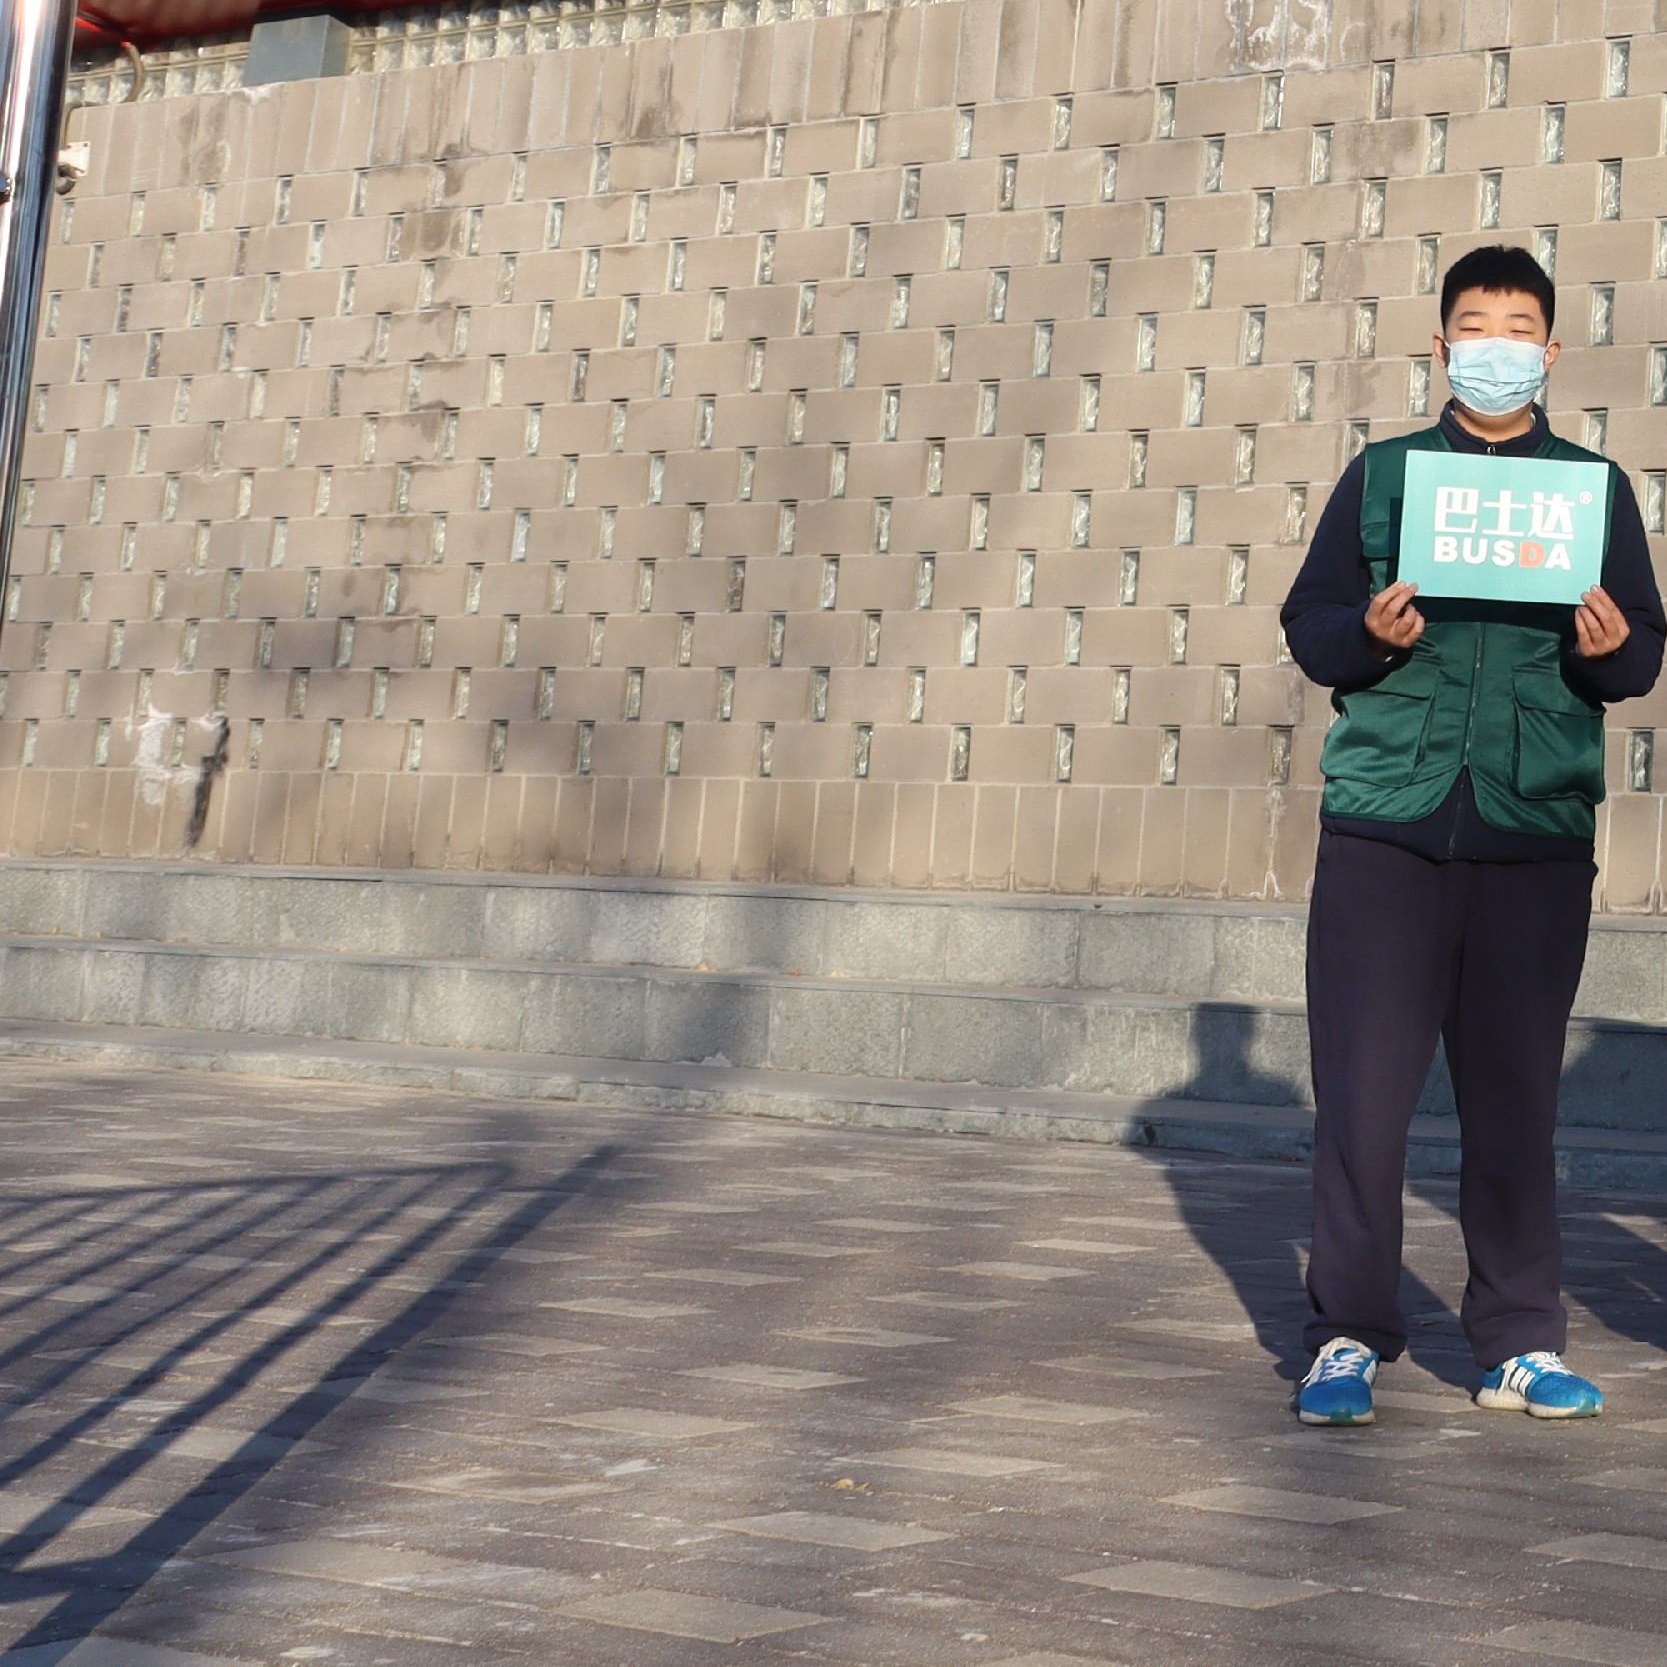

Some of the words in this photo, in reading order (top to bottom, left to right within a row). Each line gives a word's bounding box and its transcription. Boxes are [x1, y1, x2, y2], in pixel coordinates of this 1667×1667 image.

[1434, 487, 1574, 541] 巴士达
[1434, 537, 1571, 571] BUSDA
